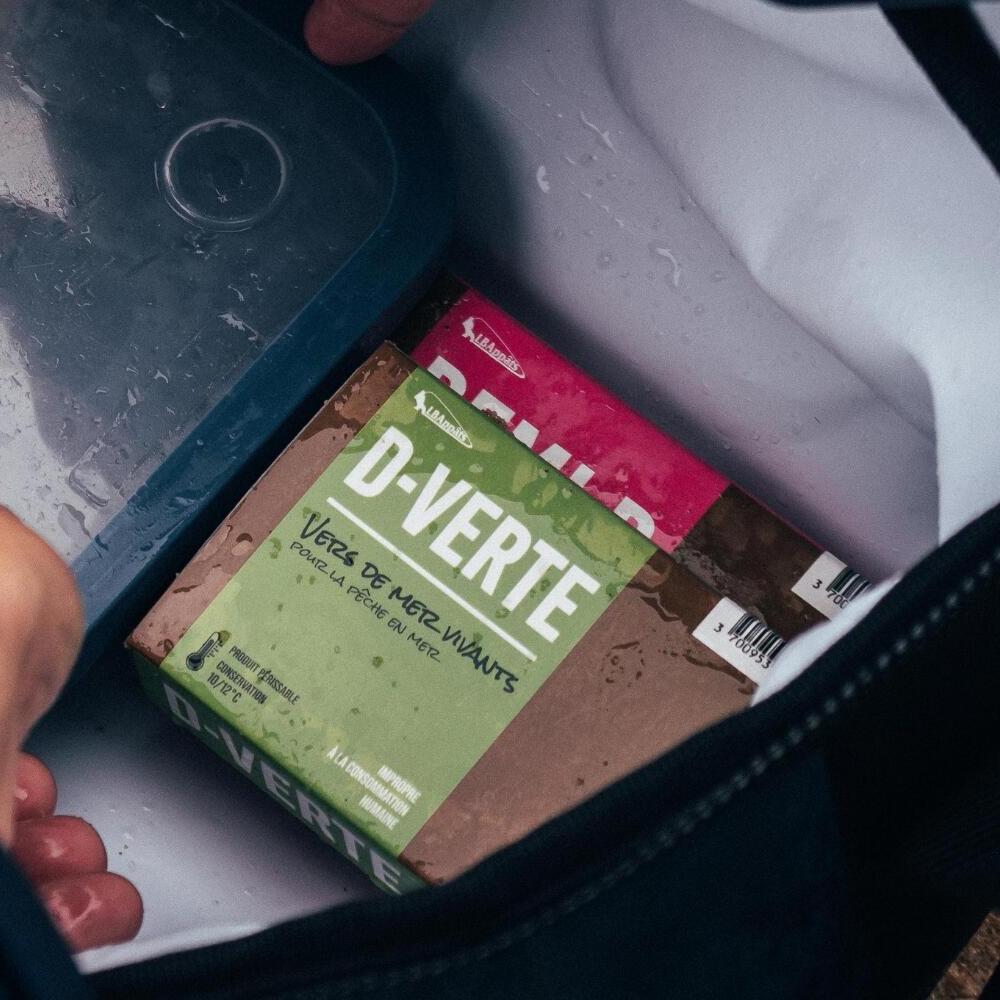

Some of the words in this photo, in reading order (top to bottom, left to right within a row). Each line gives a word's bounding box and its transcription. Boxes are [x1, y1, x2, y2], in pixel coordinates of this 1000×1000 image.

[343, 426, 601, 643] D-VERTE
[290, 541, 328, 575] POUR
[330, 571, 345, 588] LA
[347, 585, 390, 620] PÊCHE
[387, 618, 407, 635] EN
[407, 632, 441, 663] MER
[812, 578, 823, 589] 3
[361, 562, 391, 589] DE
[388, 587, 441, 634] MER
[442, 626, 519, 694] VIVANTS
[713, 622, 725, 633] 3
[729, 634, 773, 669] 700953
[207, 672, 242, 704] 10/12°C
[216, 660, 268, 704] CONSERVATION
[228, 645, 260, 673] PRODUIT
[257, 667, 300, 705] PÉRISSABLE
[162, 681, 401, 895] D-VERTE
[334, 752, 349, 768] LA
[345, 760, 410, 817] CONSOMMATION
[377, 764, 422, 804] IMPROPRE
[359, 794, 400, 831] HUMAINE
